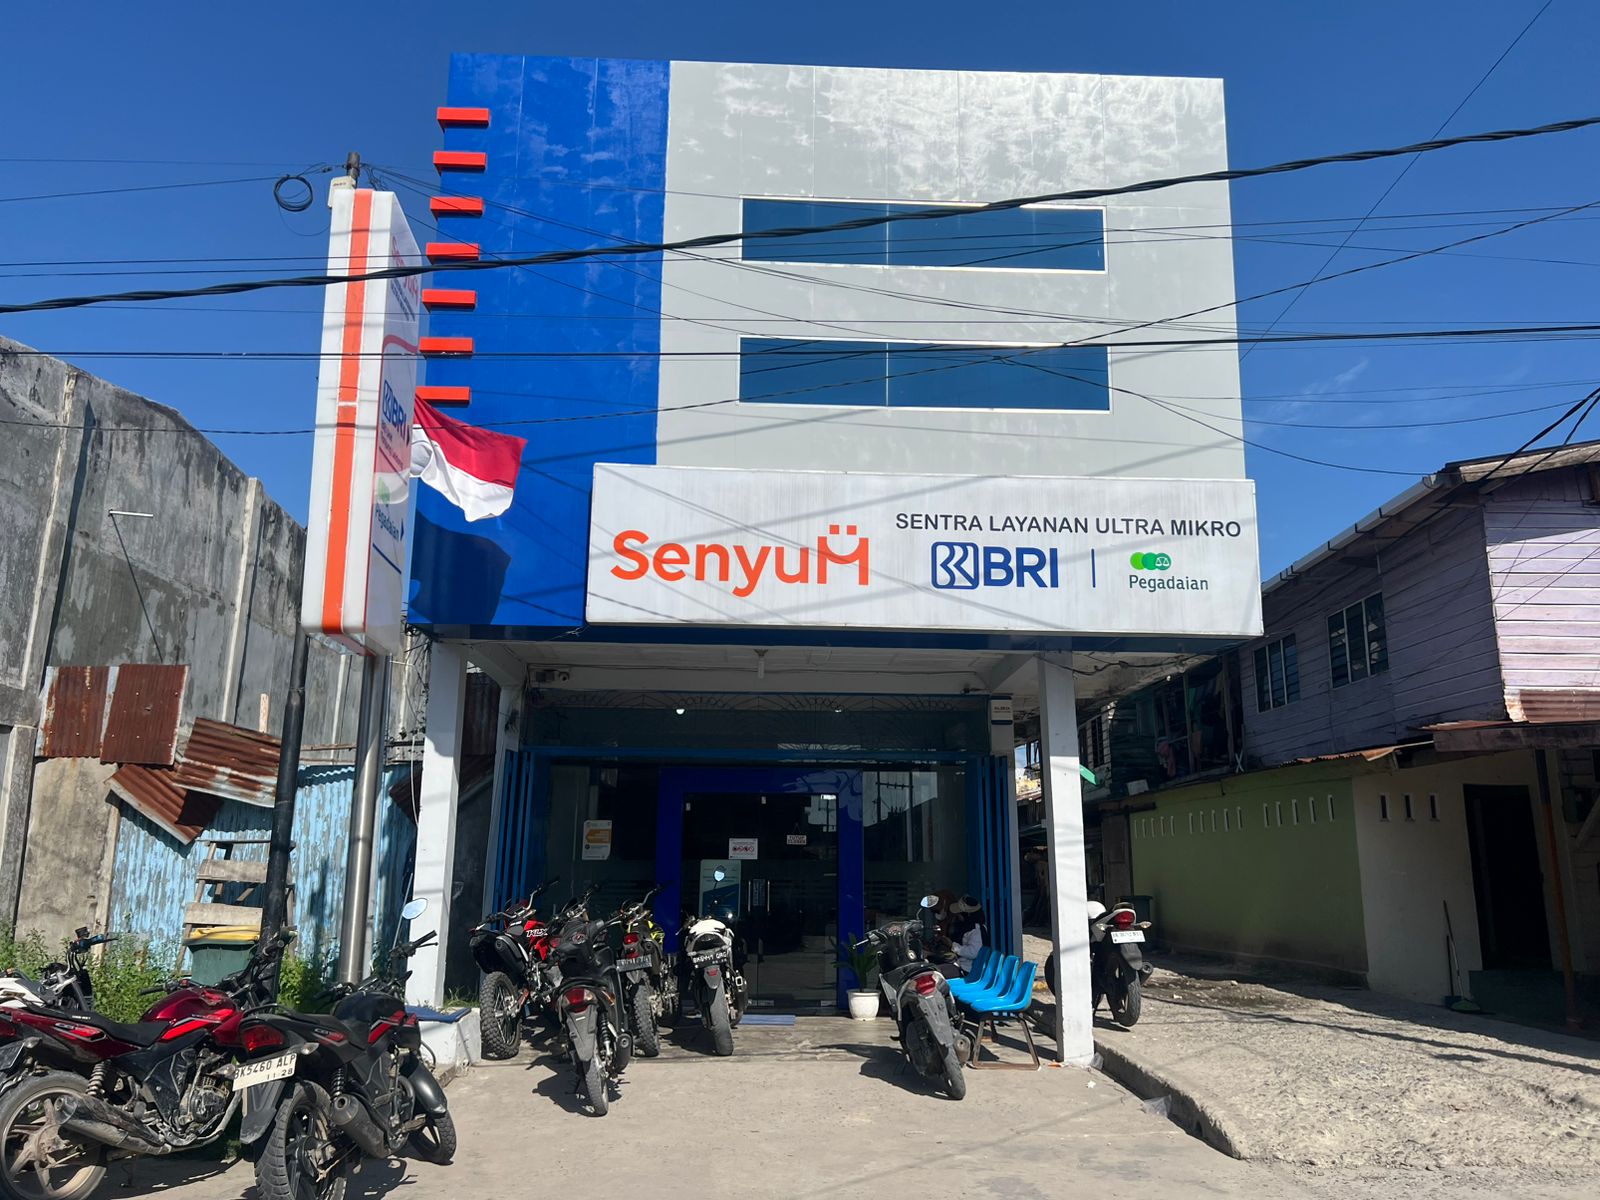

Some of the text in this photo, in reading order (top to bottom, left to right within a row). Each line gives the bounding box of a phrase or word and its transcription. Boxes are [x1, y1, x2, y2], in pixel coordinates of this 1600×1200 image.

[392, 396, 407, 442] BRI
[896, 513, 1241, 538] SENTRA LAYANAN ULTRA MIKRO
[982, 546, 1059, 588] BRI
[1129, 574, 1209, 593] Pegadaian
[276, 1054, 296, 1068] ALP
